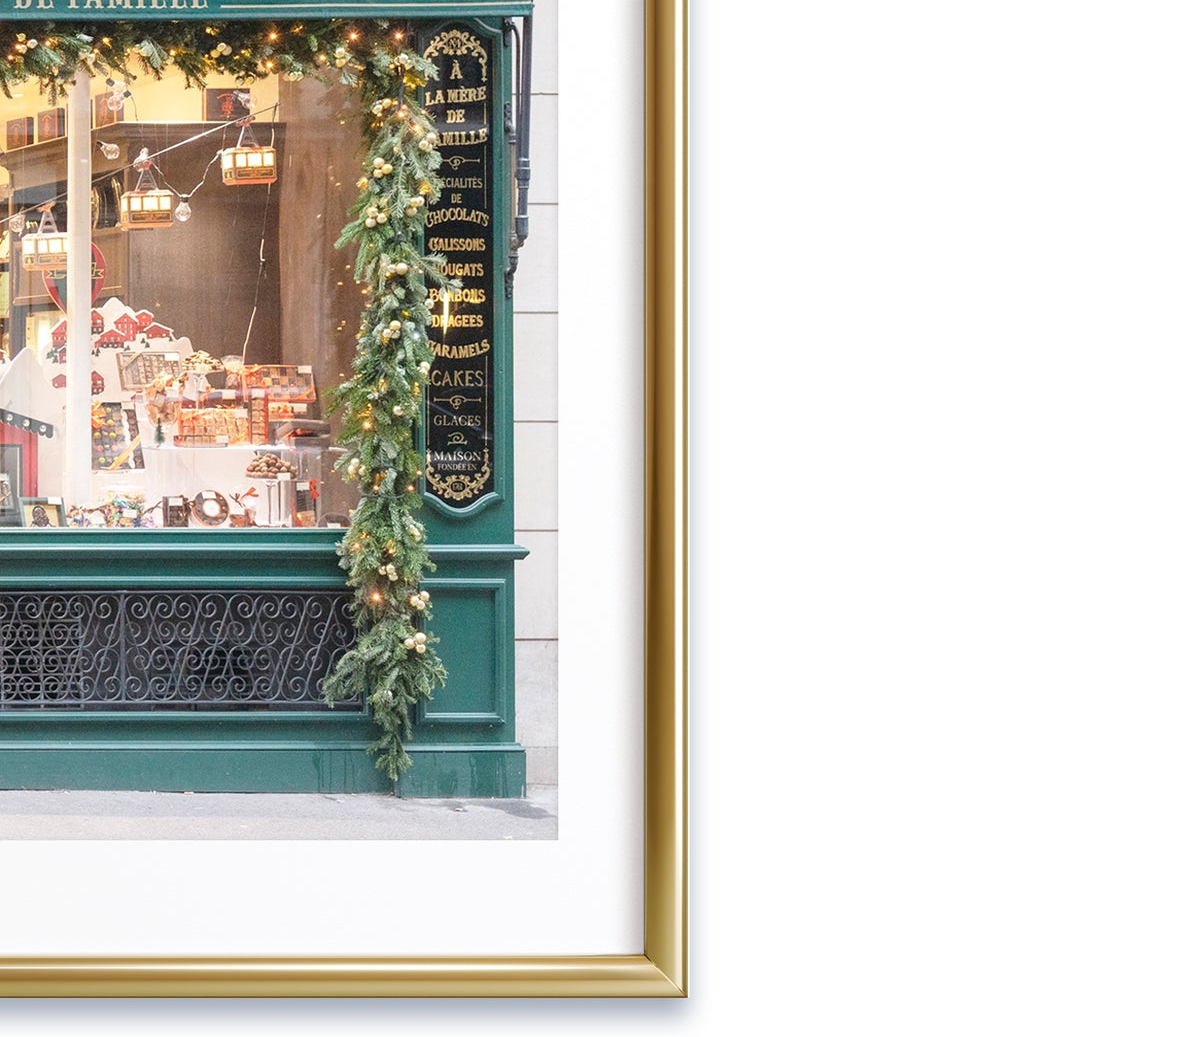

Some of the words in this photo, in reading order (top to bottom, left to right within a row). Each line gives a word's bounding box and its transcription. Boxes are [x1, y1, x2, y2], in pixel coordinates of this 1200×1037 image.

[450, 59, 463, 79] À
[425, 90, 445, 106] LA
[447, 85, 487, 103] MÈRE
[446, 109, 465, 123] DE
[435, 127, 488, 146] AMILLE
[451, 193, 462, 203] DE
[425, 207, 489, 227] CHOCOLATS
[429, 288, 486, 303] BNBONS
[431, 370, 484, 386] CAKES
[433, 415, 481, 426] GLACES
[434, 451, 481, 461] MAISON
